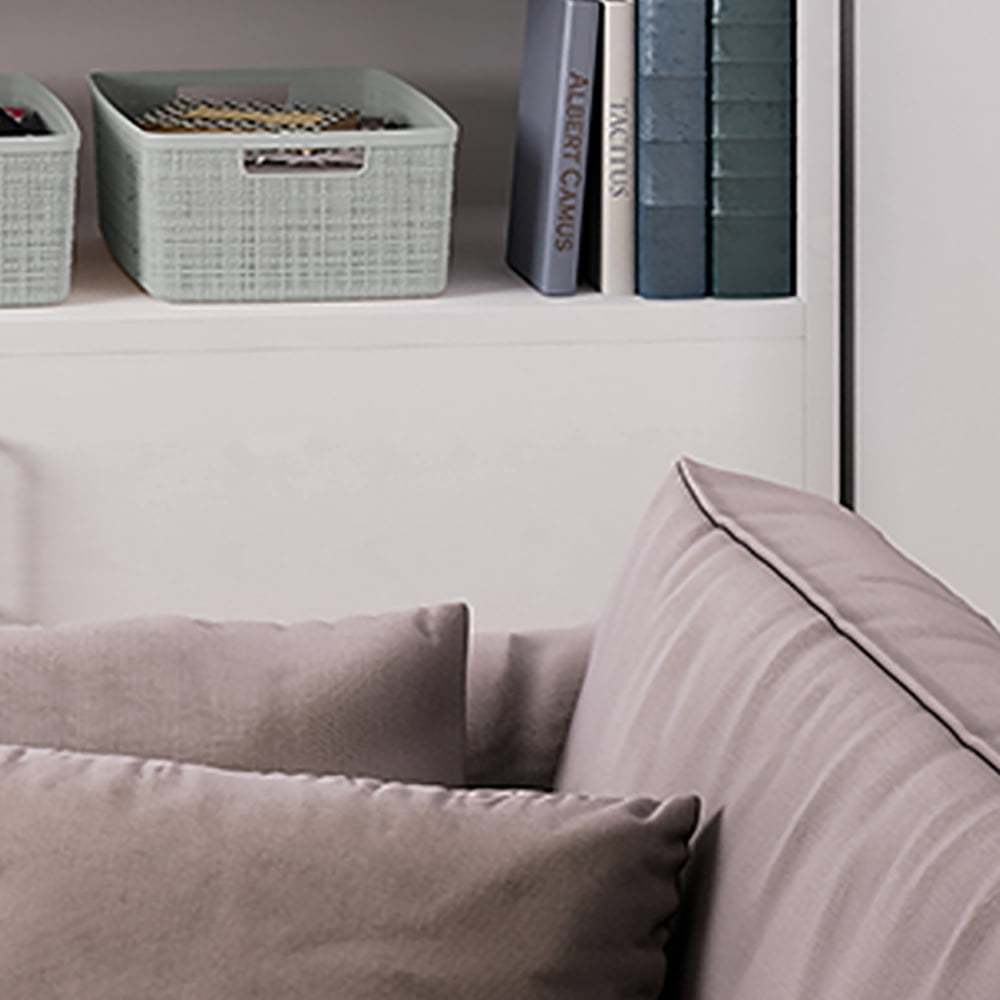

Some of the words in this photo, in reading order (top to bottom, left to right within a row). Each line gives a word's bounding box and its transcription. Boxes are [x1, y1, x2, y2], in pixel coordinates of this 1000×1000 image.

[563, 71, 589, 165] ALBERT
[609, 102, 630, 198] TACITUS
[554, 168, 583, 252] CAMUS
